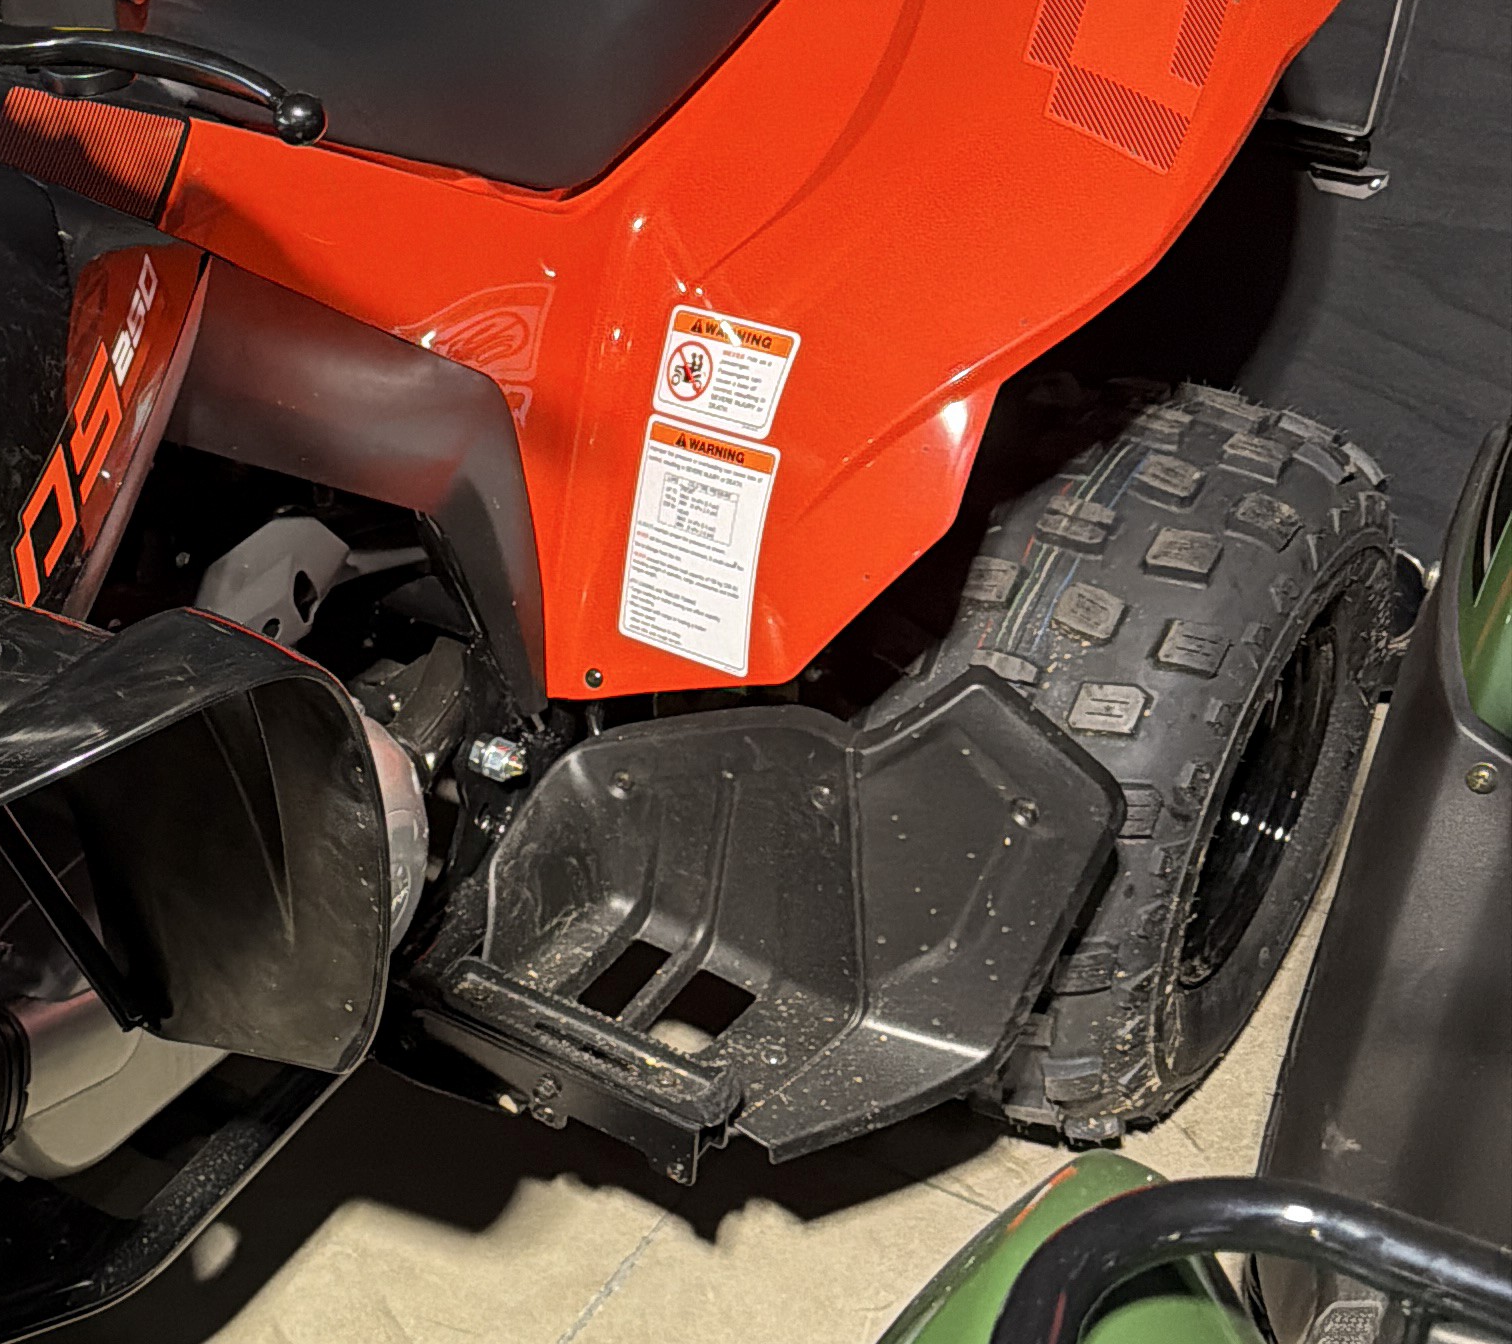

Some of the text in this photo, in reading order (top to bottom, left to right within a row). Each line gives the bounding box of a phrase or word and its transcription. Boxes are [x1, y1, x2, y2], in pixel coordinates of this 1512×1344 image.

[111, 252, 159, 388] 250
[705, 321, 773, 350] WANING
[14, 340, 123, 609] DS
[688, 437, 745, 465] WARNING
